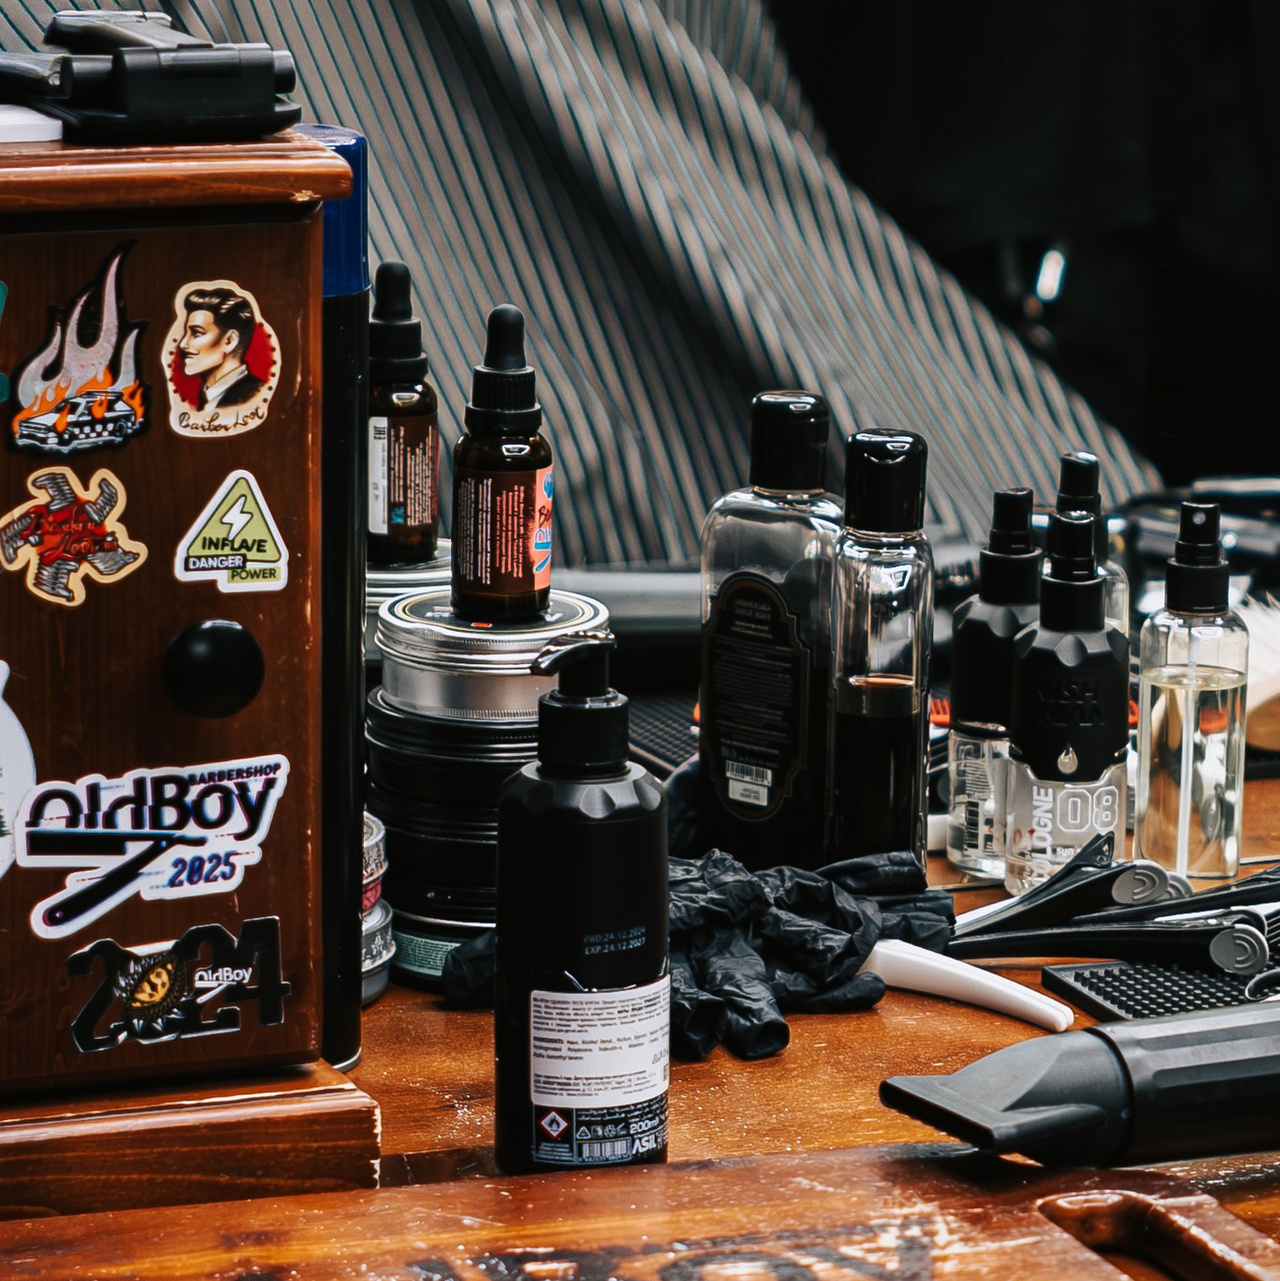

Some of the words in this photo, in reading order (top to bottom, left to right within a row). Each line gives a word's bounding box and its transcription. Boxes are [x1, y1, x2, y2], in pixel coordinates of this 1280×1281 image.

[188, 555, 245, 571] DANGER
[230, 568, 278, 581] POWER
[188, 762, 282, 787] BARBERSHOP
[25, 773, 278, 841] OldBoy
[1057, 785, 1119, 836] 08
[166, 850, 238, 888] 2025
[194, 967, 253, 984] OldBoy
